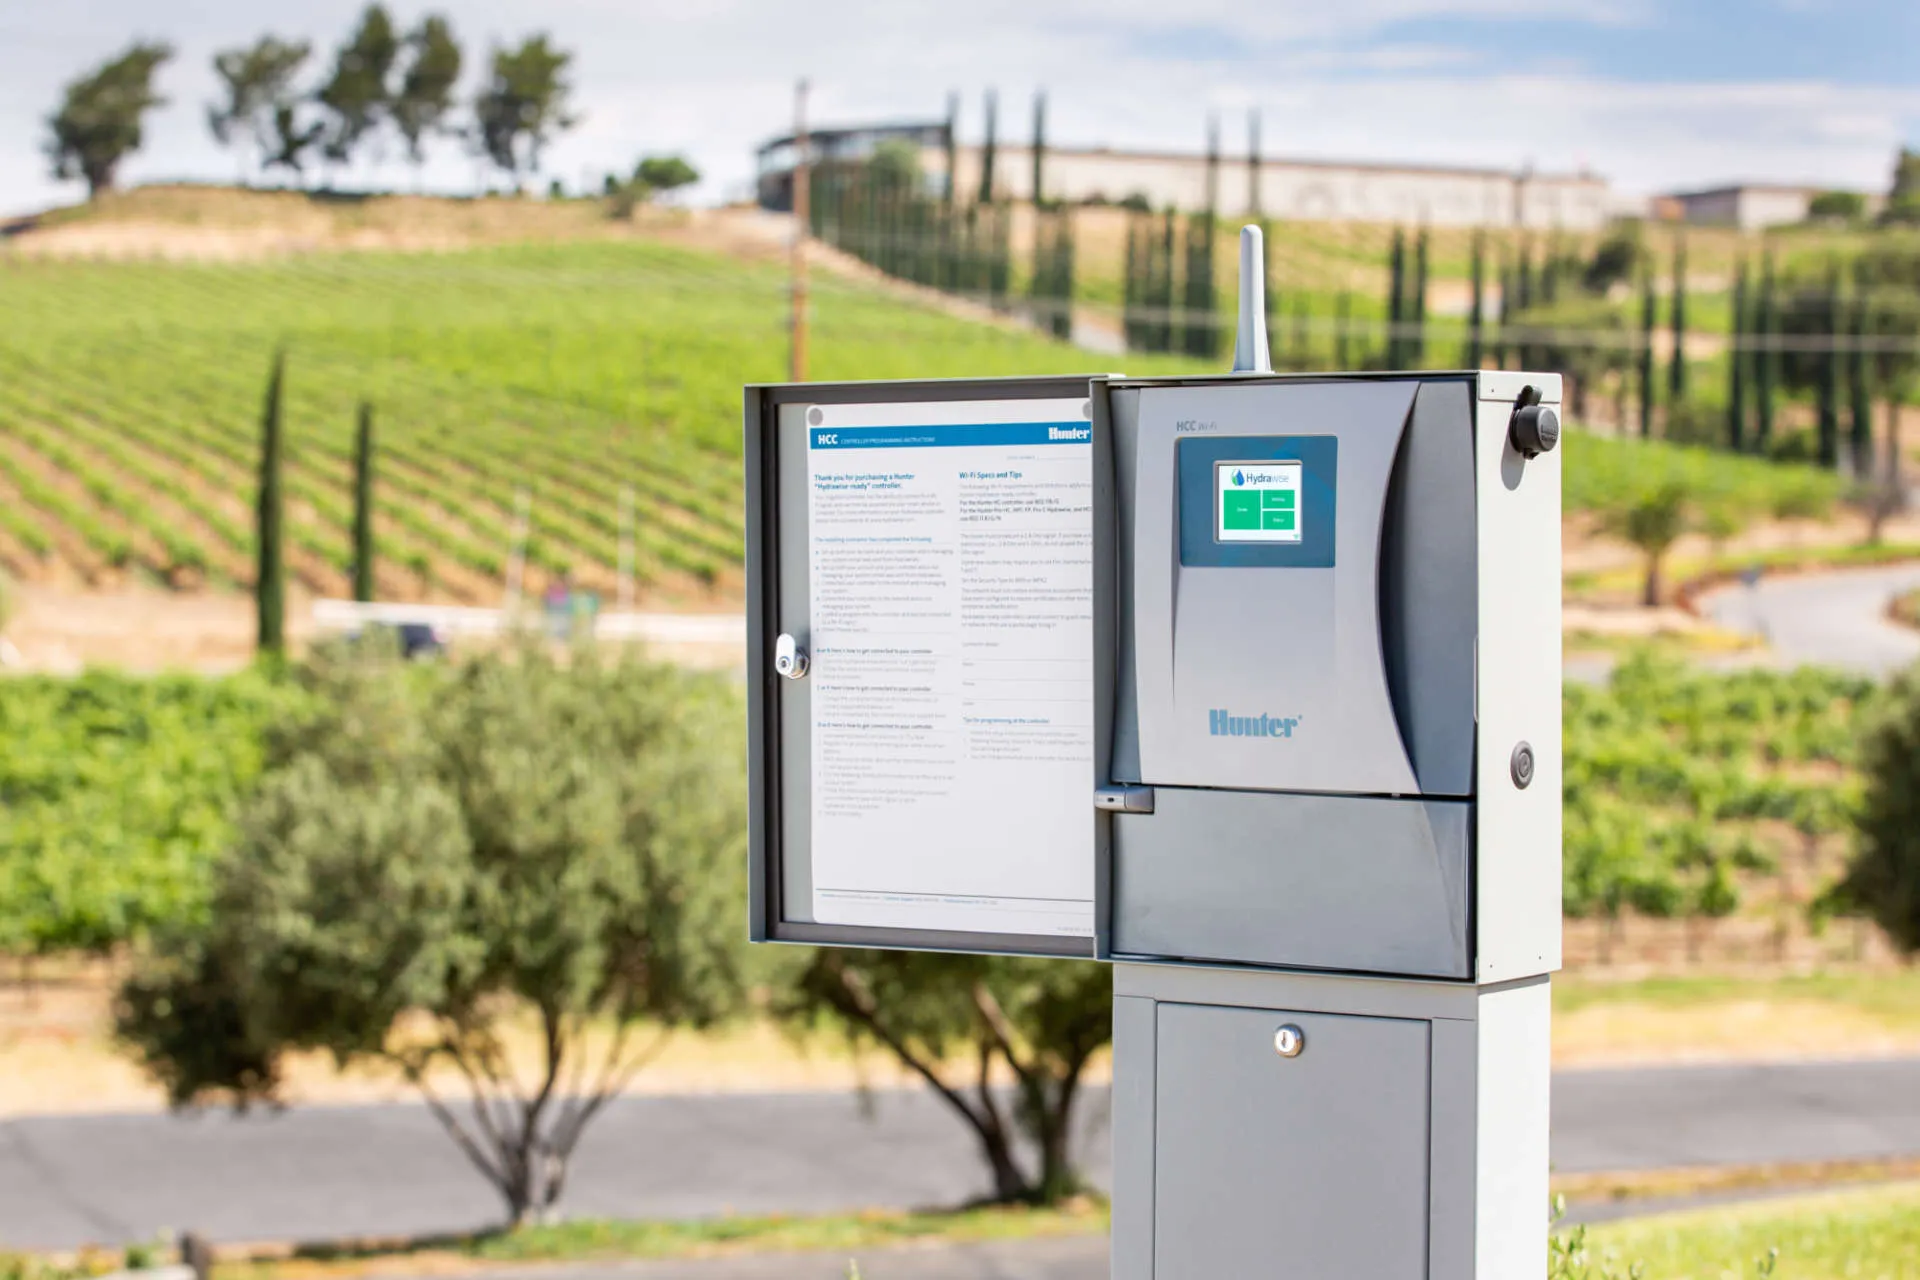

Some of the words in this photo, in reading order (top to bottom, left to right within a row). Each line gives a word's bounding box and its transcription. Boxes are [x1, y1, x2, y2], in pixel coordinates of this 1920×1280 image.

[1176, 420, 1196, 431] HCC
[1048, 427, 1090, 440] Hunter
[818, 434, 838, 445] HCC
[833, 475, 844, 483] you
[855, 473, 888, 482] purchasing
[959, 471, 976, 479] Wi-Fi
[977, 471, 995, 480] Specs
[996, 471, 1007, 479] and
[1009, 471, 1022, 480] Tips
[1208, 708, 1299, 738] Hunter
